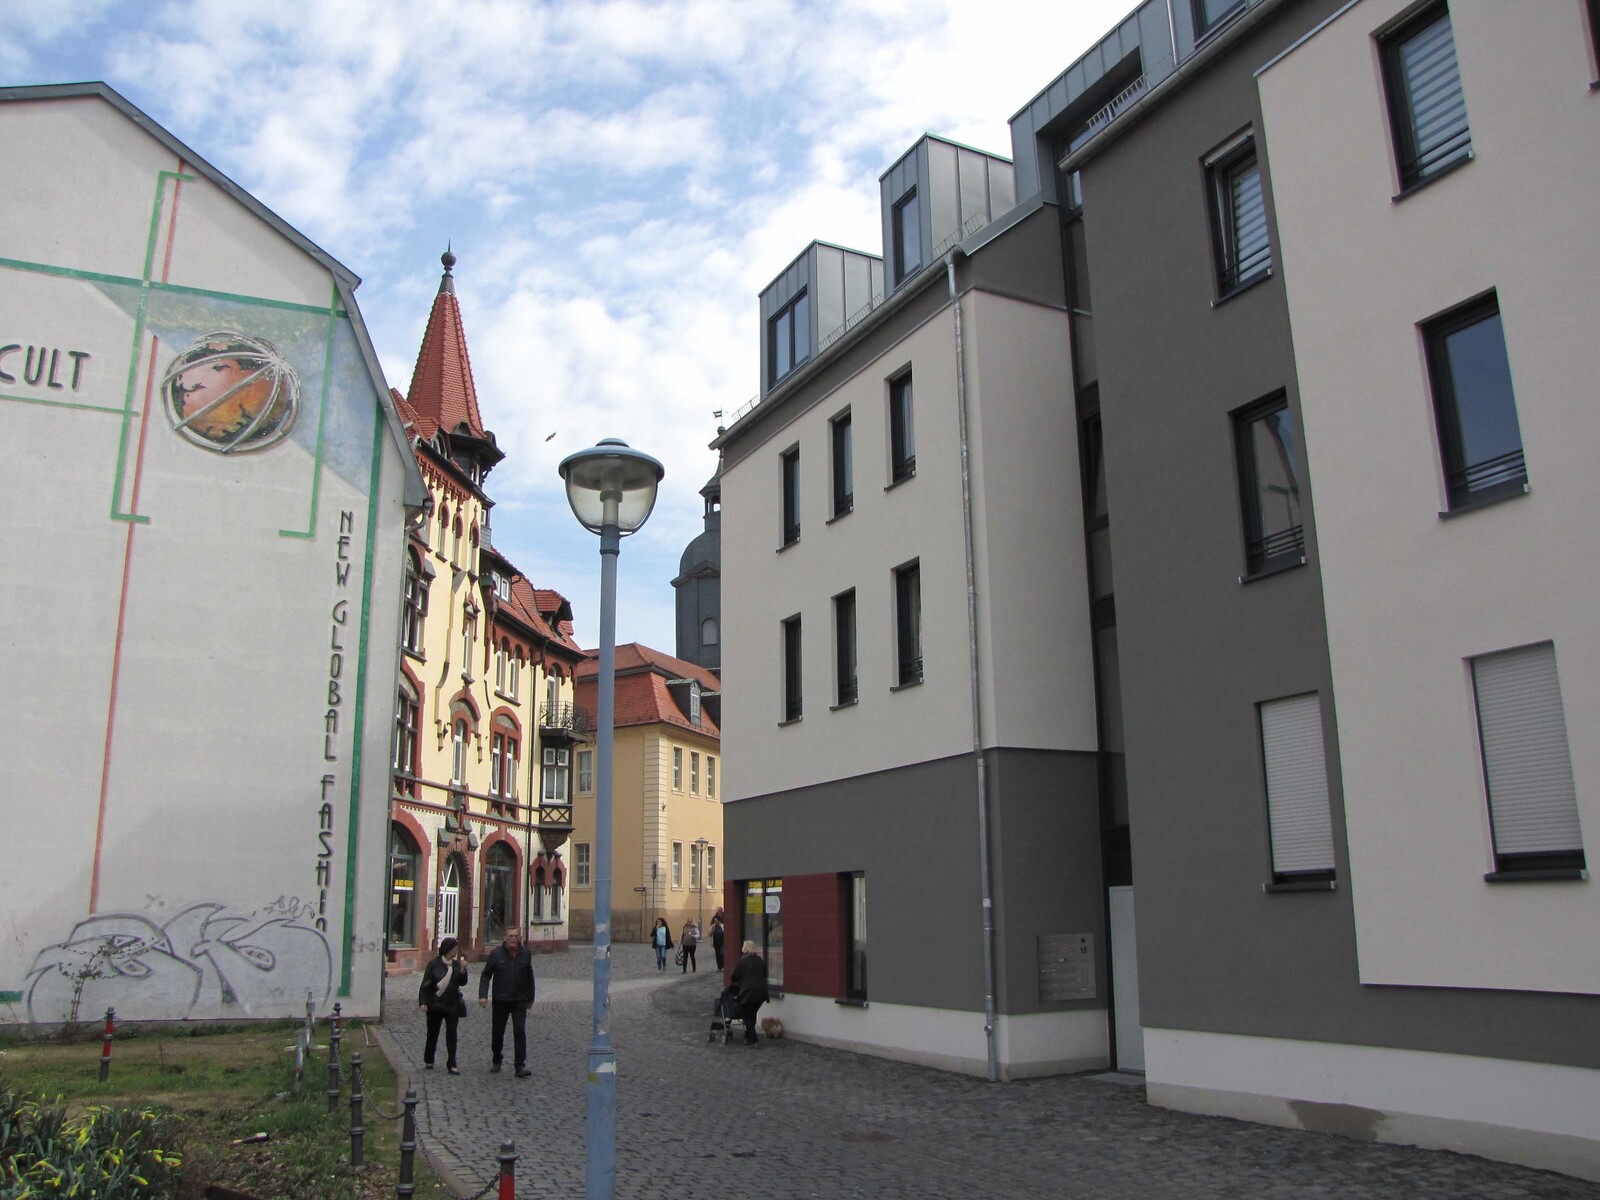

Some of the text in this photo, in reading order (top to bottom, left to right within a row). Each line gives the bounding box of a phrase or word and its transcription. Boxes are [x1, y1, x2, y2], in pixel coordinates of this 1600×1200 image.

[0, 344, 91, 391] CULT
[336, 510, 353, 586] NEW
[324, 599, 348, 761] GLOBAL
